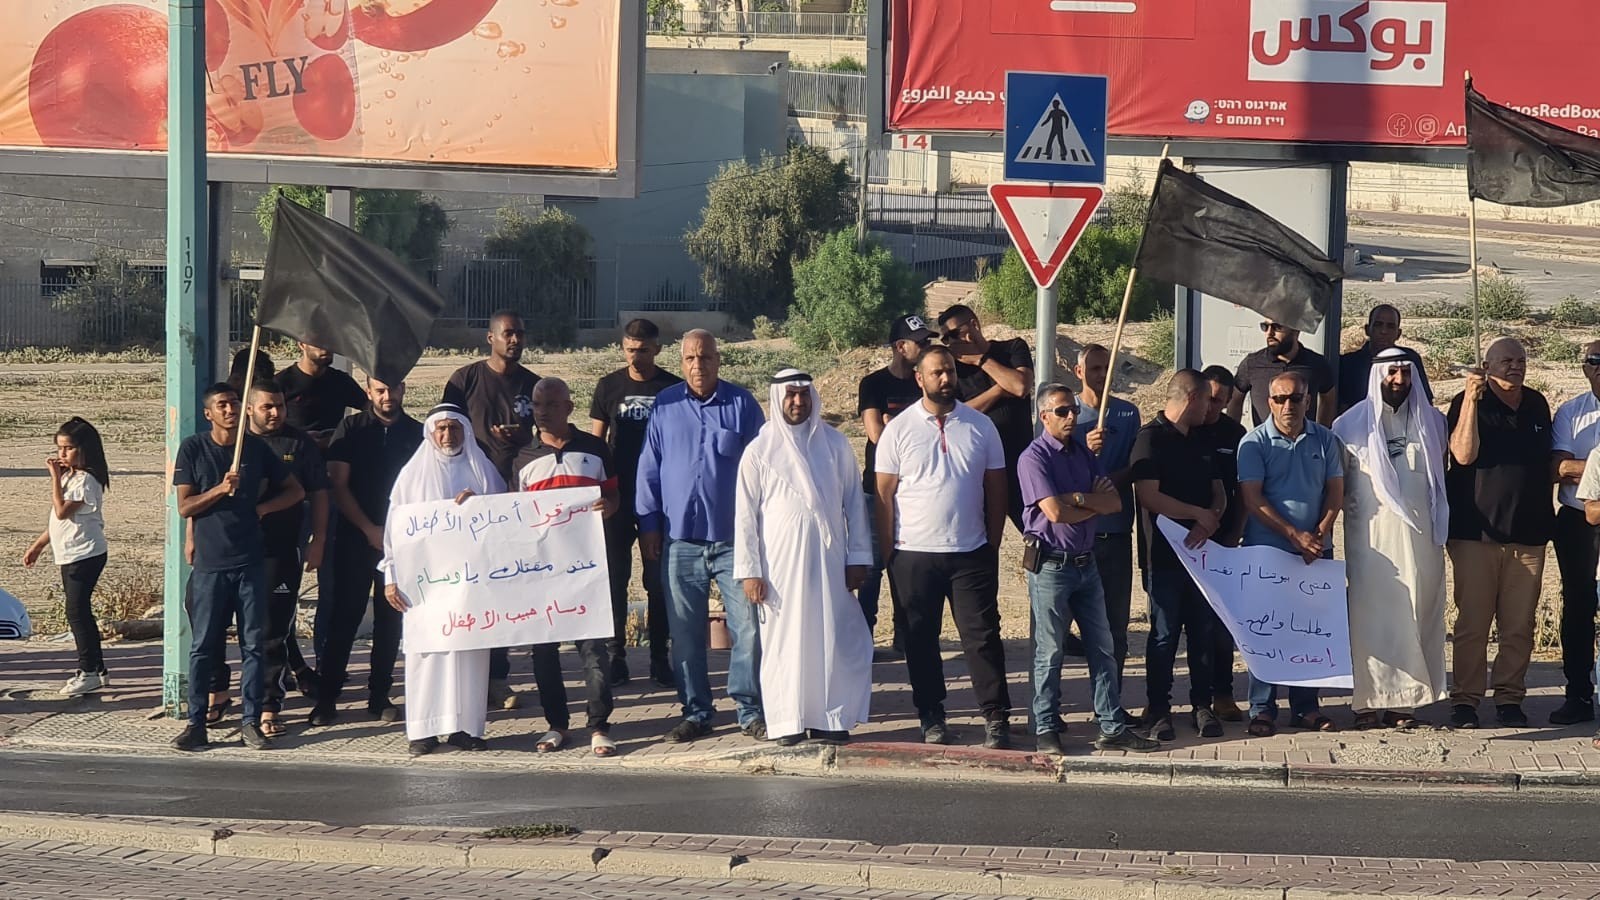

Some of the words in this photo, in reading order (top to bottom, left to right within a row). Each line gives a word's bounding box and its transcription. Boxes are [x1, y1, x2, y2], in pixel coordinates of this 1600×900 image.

[1252, 1, 1433, 70] بوكس
[239, 56, 308, 100] FLY
[901, 86, 951, 104] الفروع
[954, 89, 996, 105] جميع
[1213, 99, 1242, 109] רהט:
[1245, 101, 1288, 111] אמיגוס
[1215, 114, 1223, 124] 5
[1226, 115, 1262, 125] מתחם
[1265, 116, 1285, 126] וייז
[898, 134, 928, 149] 14
[183, 236, 193, 294] 1107
[469, 500, 523, 541] أحلام
[566, 560, 598, 574] عند
[416, 567, 461, 603] وسام
[1299, 580, 1332, 596] حتى
[505, 607, 538, 625] حبيب
[545, 599, 587, 626] وسام
